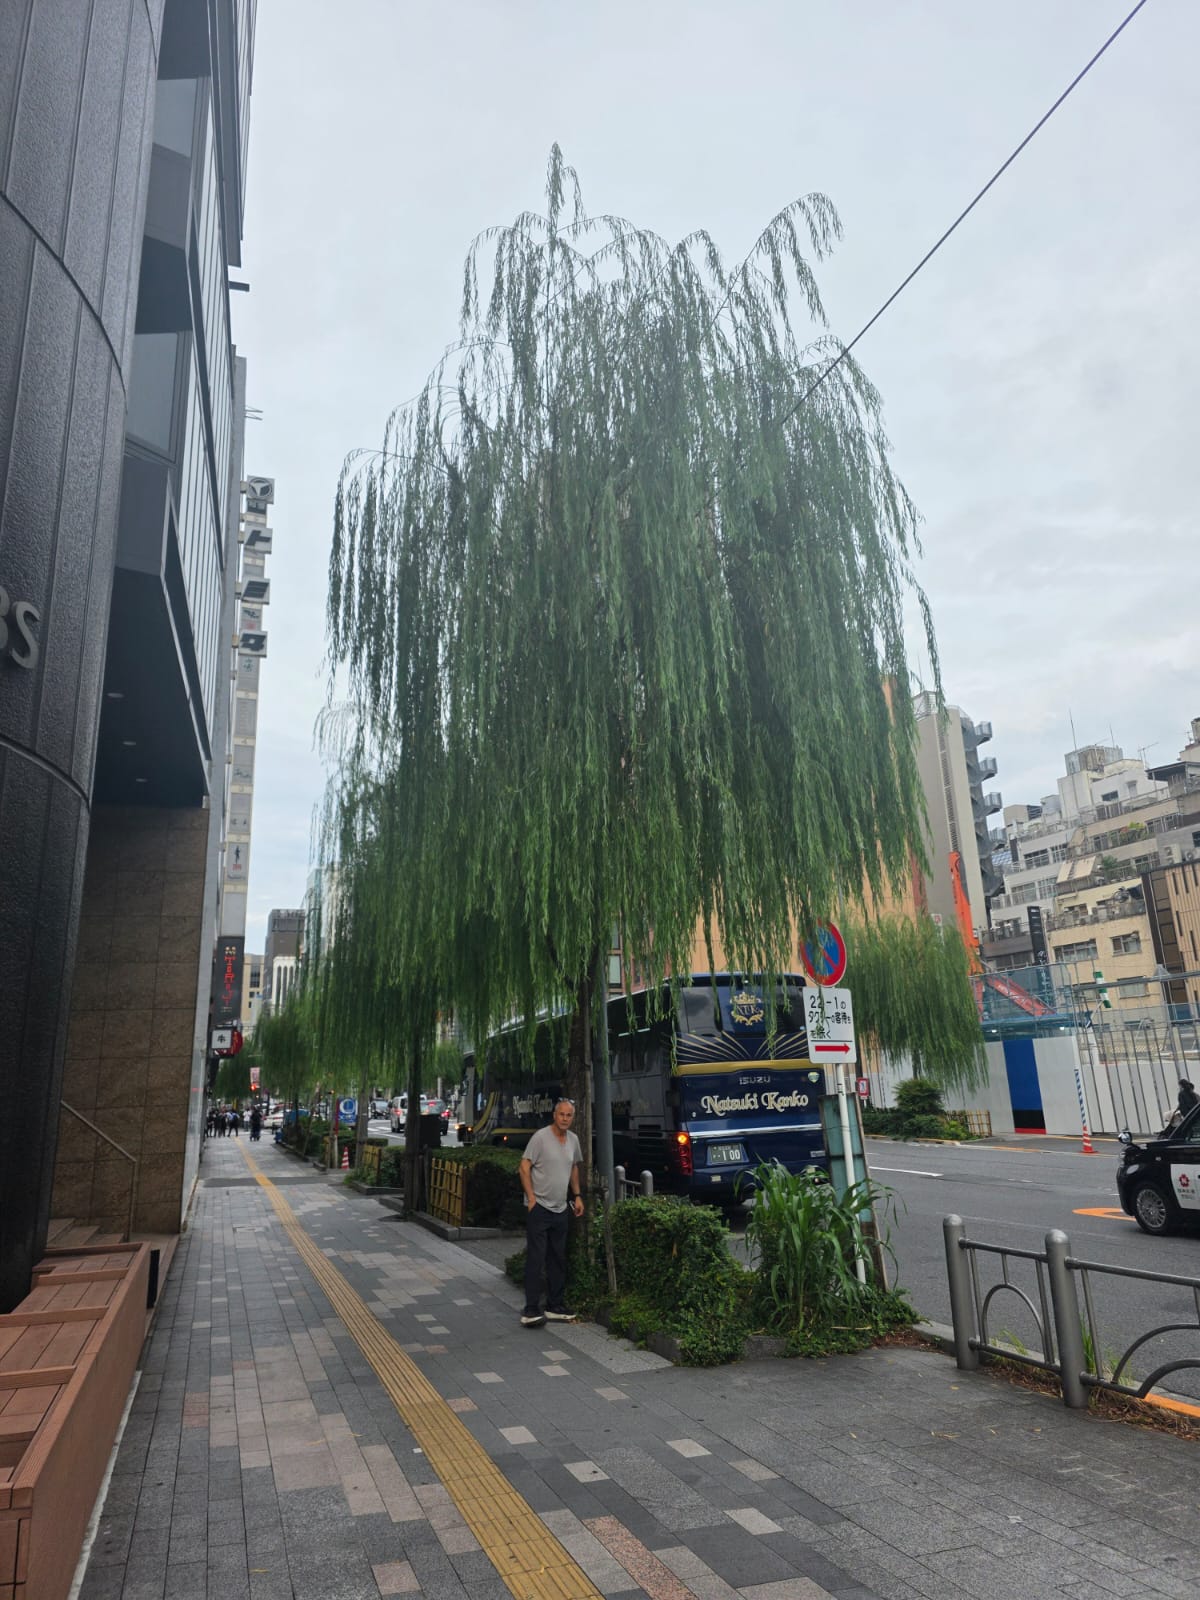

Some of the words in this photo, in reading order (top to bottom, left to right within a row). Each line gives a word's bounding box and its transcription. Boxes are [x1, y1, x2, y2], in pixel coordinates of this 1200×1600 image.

[739, 1076, 771, 1085] ISUZU
[701, 1093, 760, 1117] Natsuki
[761, 1090, 809, 1113] Kanko
